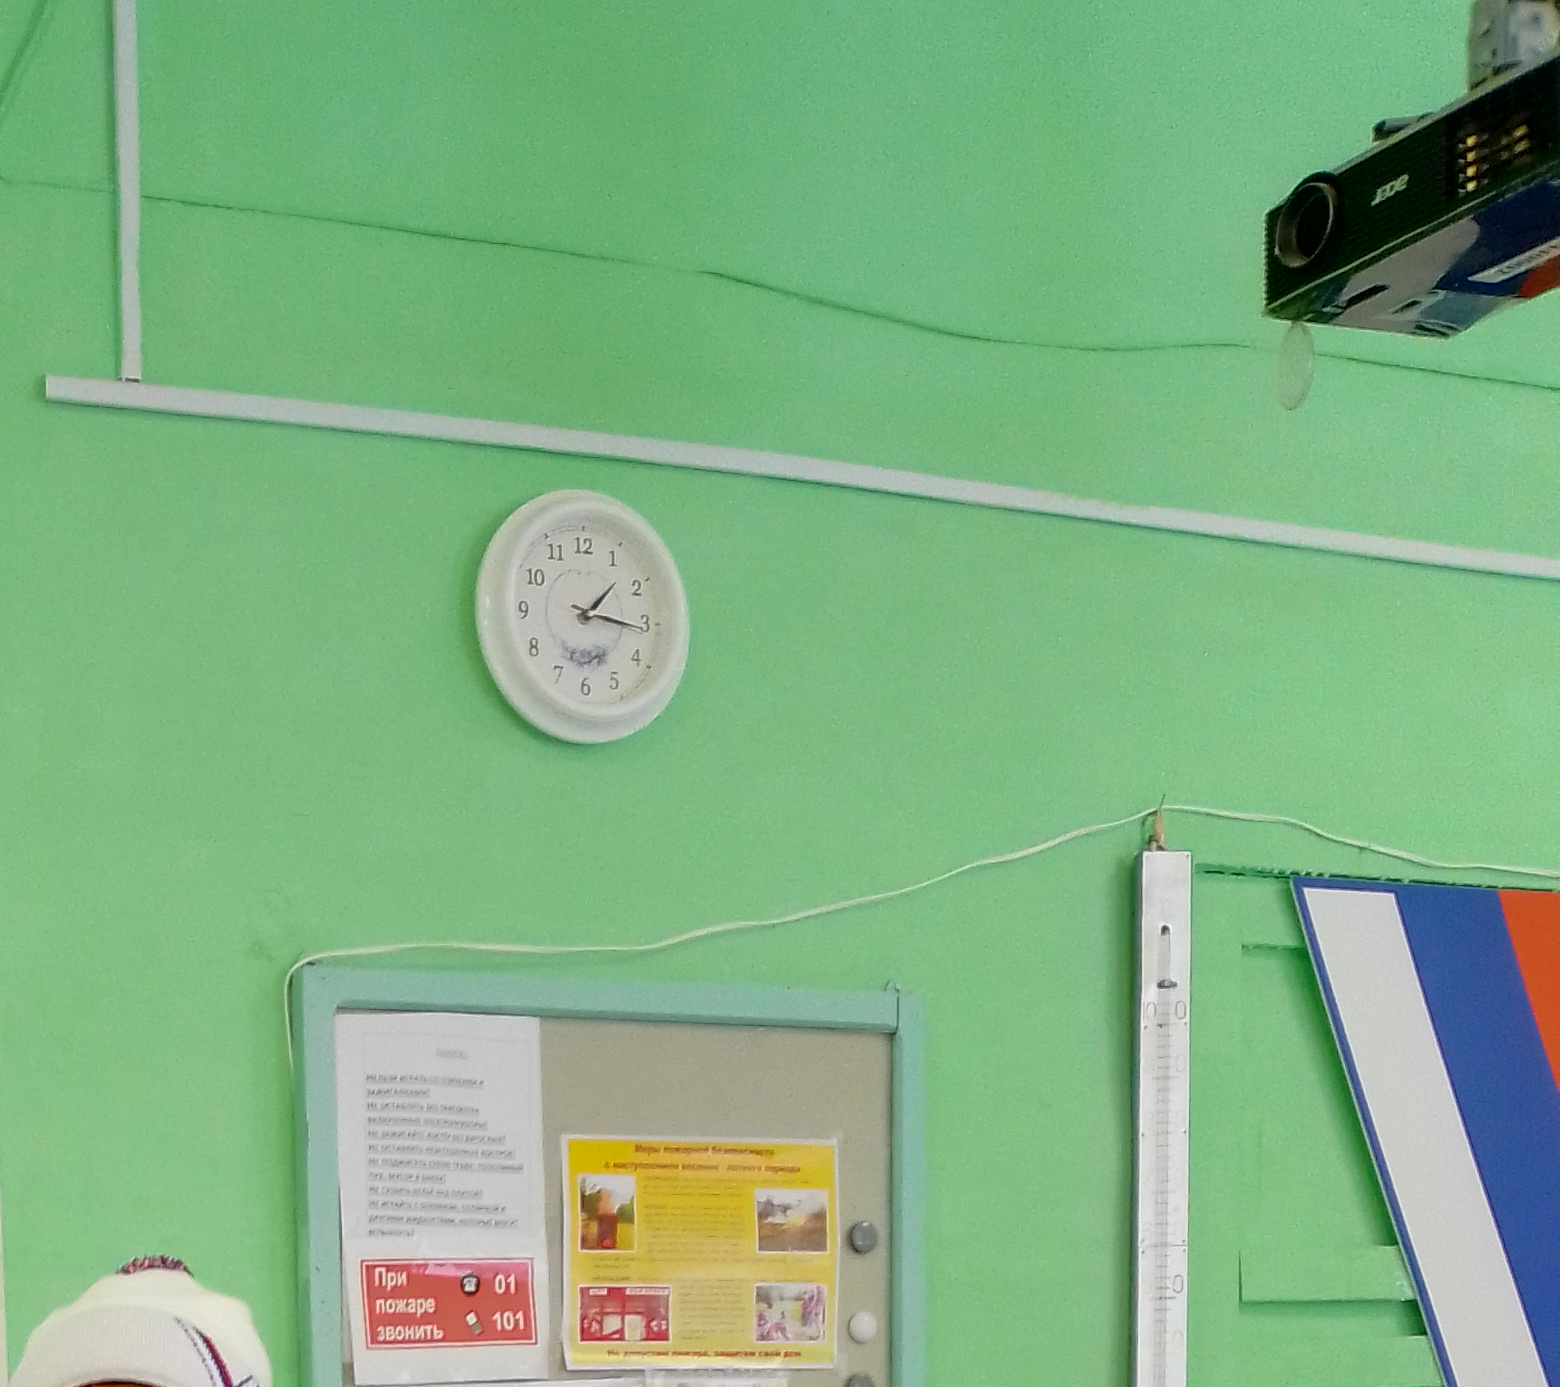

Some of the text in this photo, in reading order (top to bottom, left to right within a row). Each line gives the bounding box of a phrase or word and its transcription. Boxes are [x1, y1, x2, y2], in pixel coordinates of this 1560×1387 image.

[547, 543, 564, 561] 11
[574, 536, 594, 556] 12
[608, 550, 618, 567] 1
[526, 568, 545, 586] 10
[631, 579, 643, 597] 2
[518, 600, 529, 619] 9
[640, 614, 651, 633] 3
[529, 637, 539, 657] 8
[631, 648, 642, 667] 4
[553, 665, 565, 684] 7
[609, 671, 620, 690] 5
[580, 677, 592, 696] 6
[373, 1267, 407, 1291] При
[493, 1273, 517, 1295] 01
[375, 1297, 436, 1319] пожаре
[492, 1310, 526, 1332] 101
[376, 1325, 444, 1342] звонить
